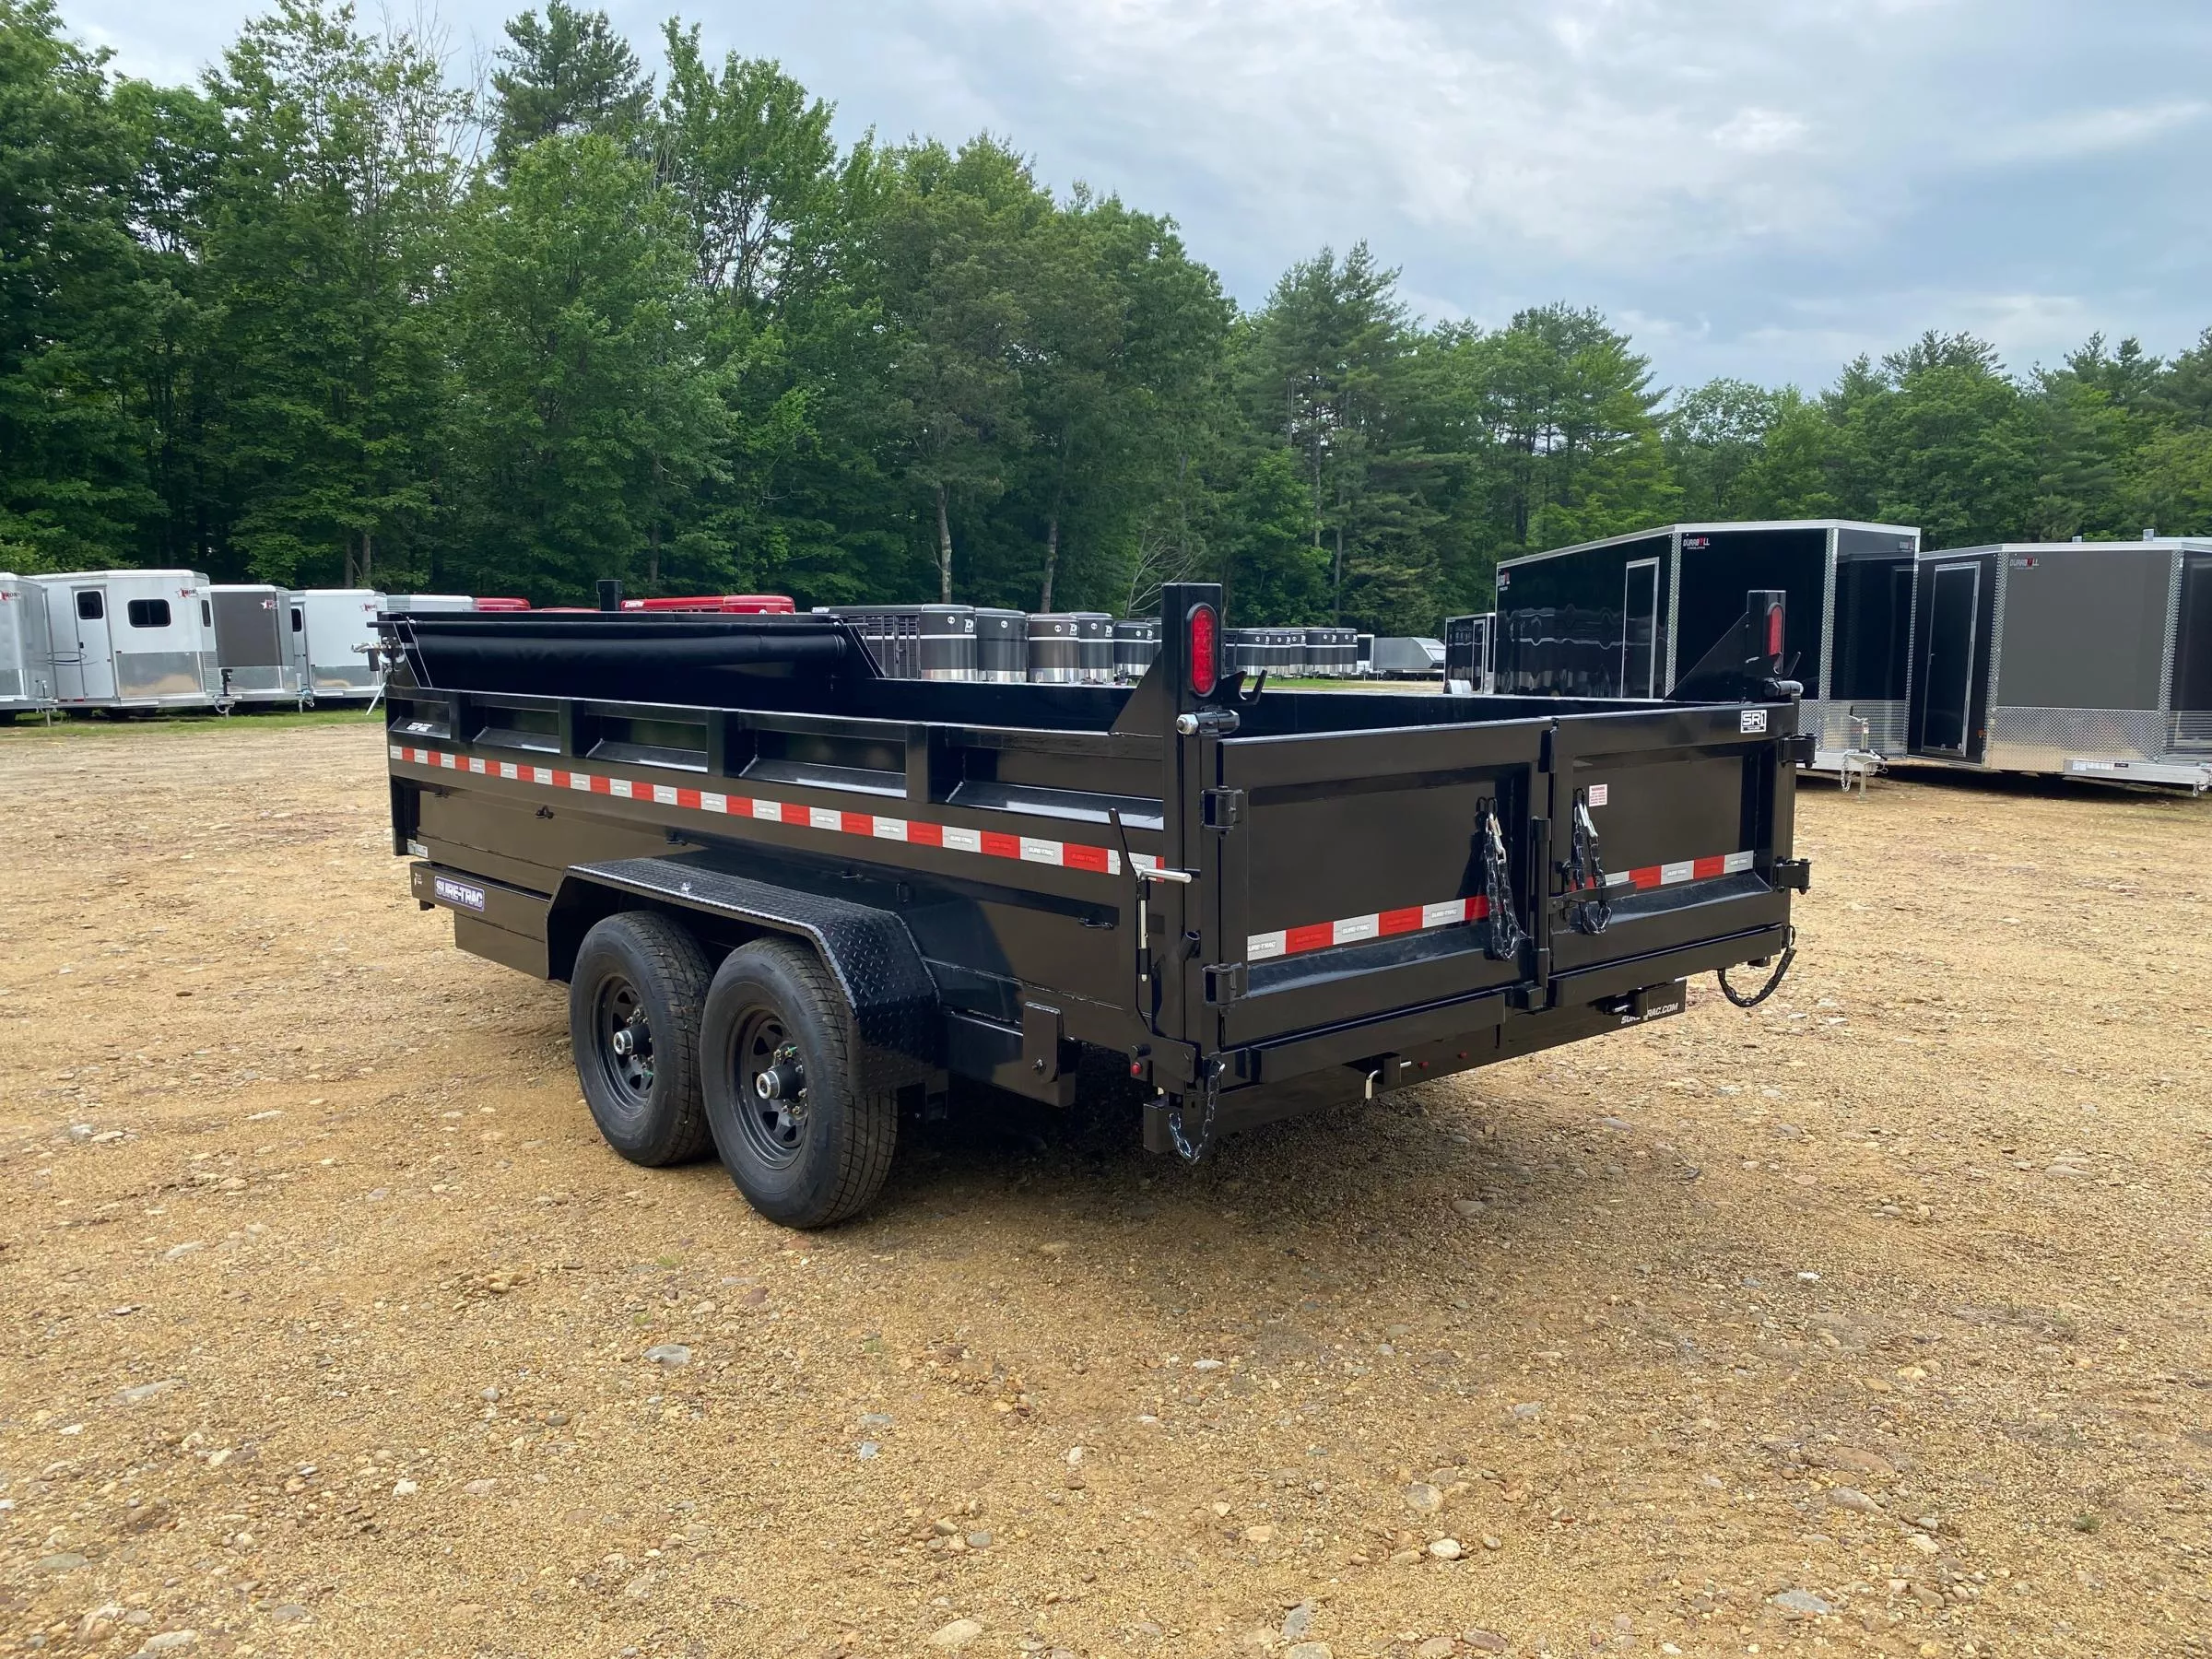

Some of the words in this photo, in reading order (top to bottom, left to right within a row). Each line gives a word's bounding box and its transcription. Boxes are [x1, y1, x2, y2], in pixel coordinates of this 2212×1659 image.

[436, 879, 483, 908] SURE-TRAC
[1247, 941, 1277, 952] URE-TRAC
[1621, 1002, 1678, 1025] SURAC.COM
